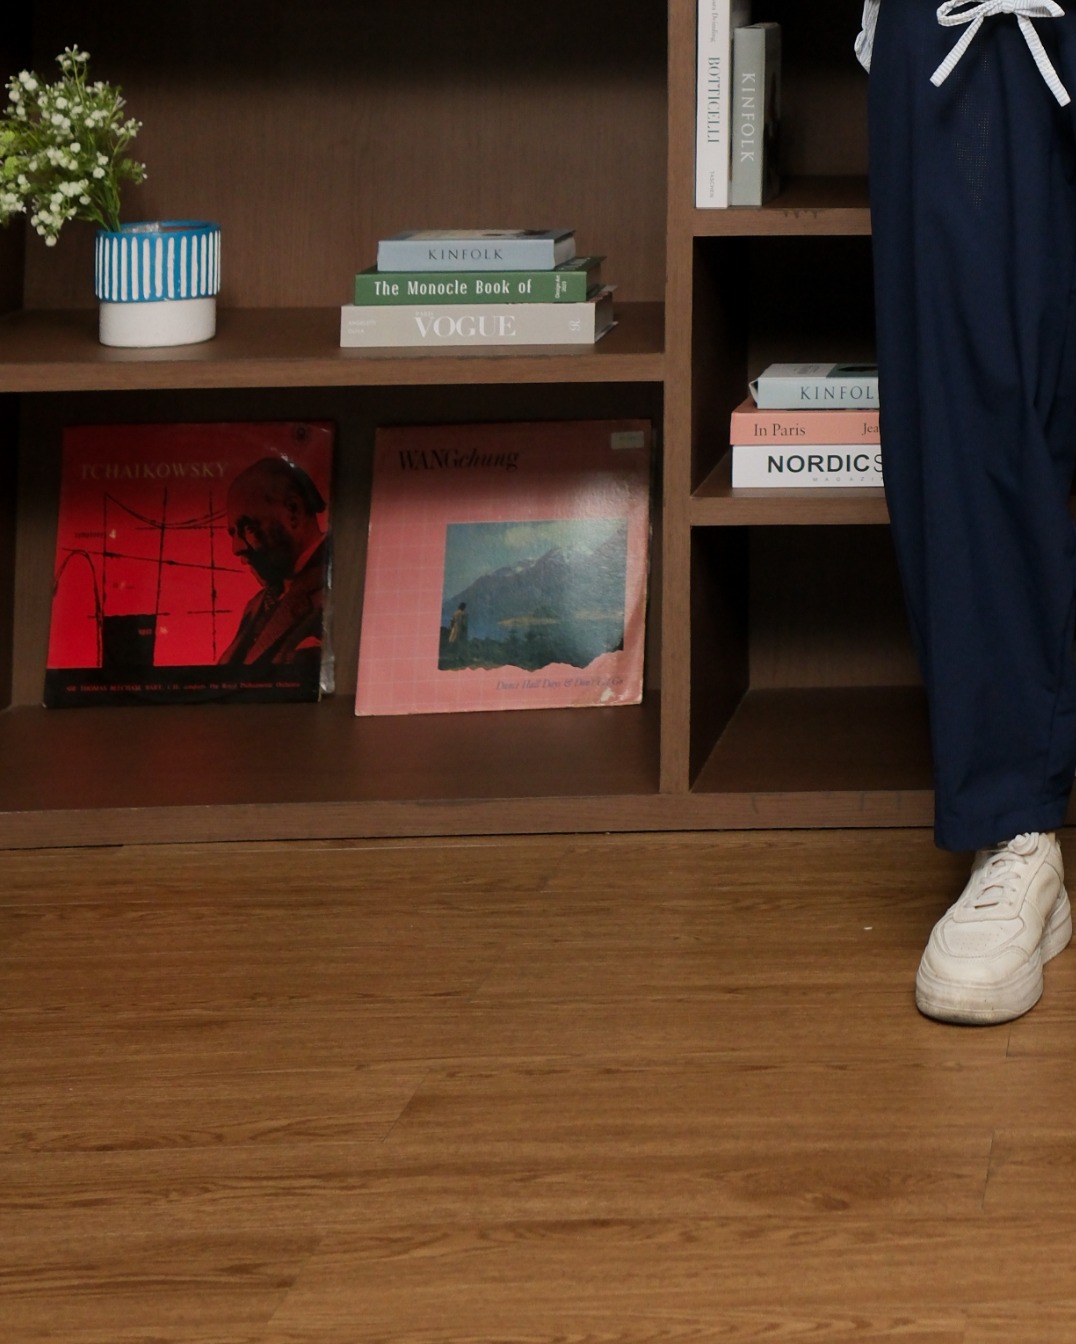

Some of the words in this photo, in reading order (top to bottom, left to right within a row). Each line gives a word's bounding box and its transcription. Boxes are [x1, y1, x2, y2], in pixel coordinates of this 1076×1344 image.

[707, 57, 720, 143] BOTTICELLI
[740, 72, 756, 163] KINFOLK
[428, 248, 503, 260] KINFOLK
[375, 281, 399, 296] The
[407, 280, 467, 295] Monocle
[476, 279, 510, 294] Book
[518, 279, 532, 294] of
[414, 315, 516, 338] VOGUE
[801, 386, 879, 400] KINFOL
[754, 424, 767, 436] In
[772, 423, 806, 436] Paris
[81, 462, 226, 480] TCHAIKOWSKY
